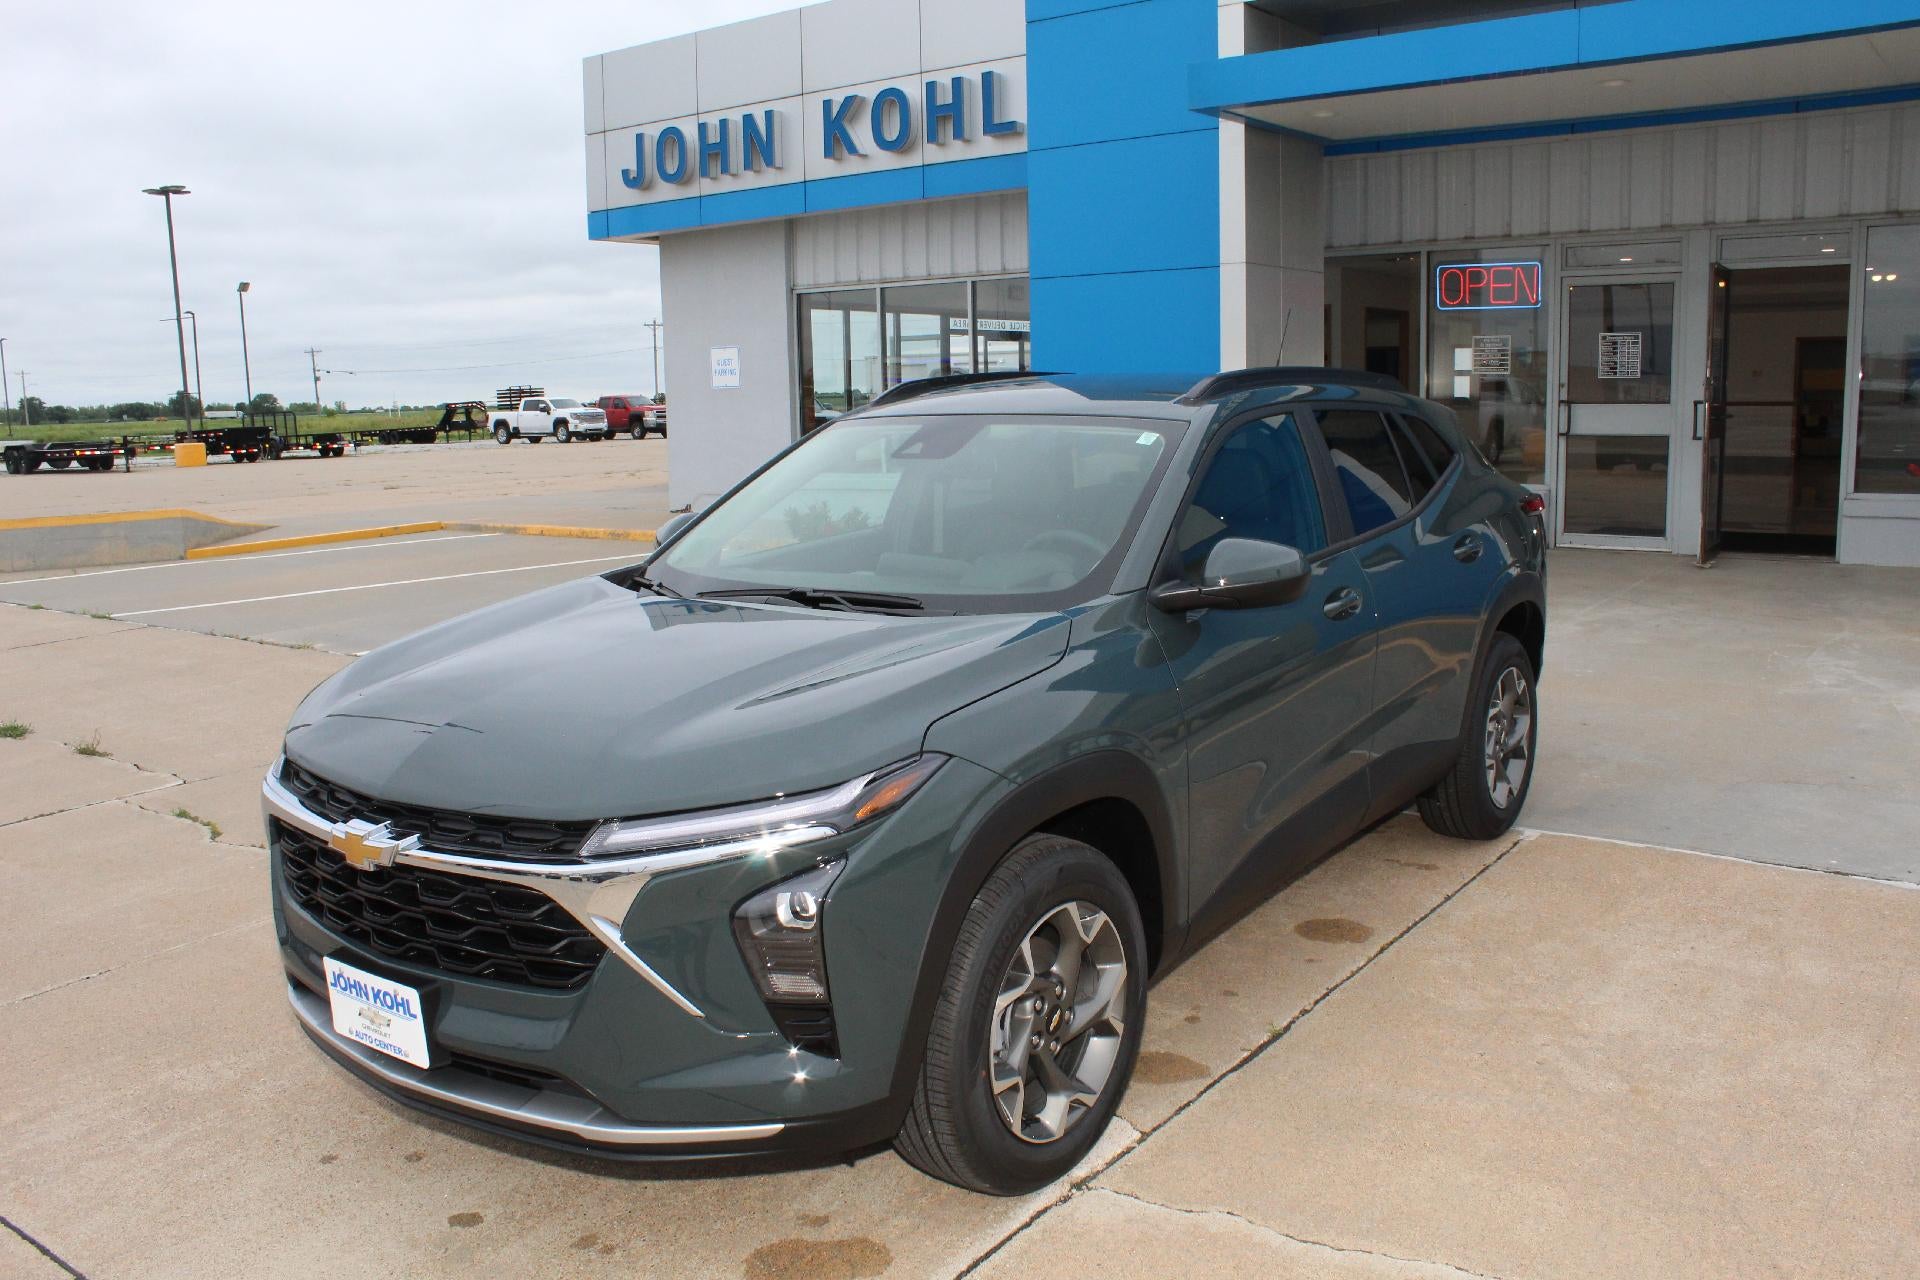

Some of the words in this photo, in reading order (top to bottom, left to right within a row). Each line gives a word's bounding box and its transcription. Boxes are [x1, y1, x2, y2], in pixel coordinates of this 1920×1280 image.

[621, 109, 781, 190] JOHN
[823, 70, 1022, 160] KOHL
[1441, 265, 1538, 305] OPEN
[330, 970, 370, 1002] JOHN
[371, 986, 417, 1019] KOHL
[354, 1029, 374, 1044] AUTO
[374, 1037, 404, 1057] CENTER
